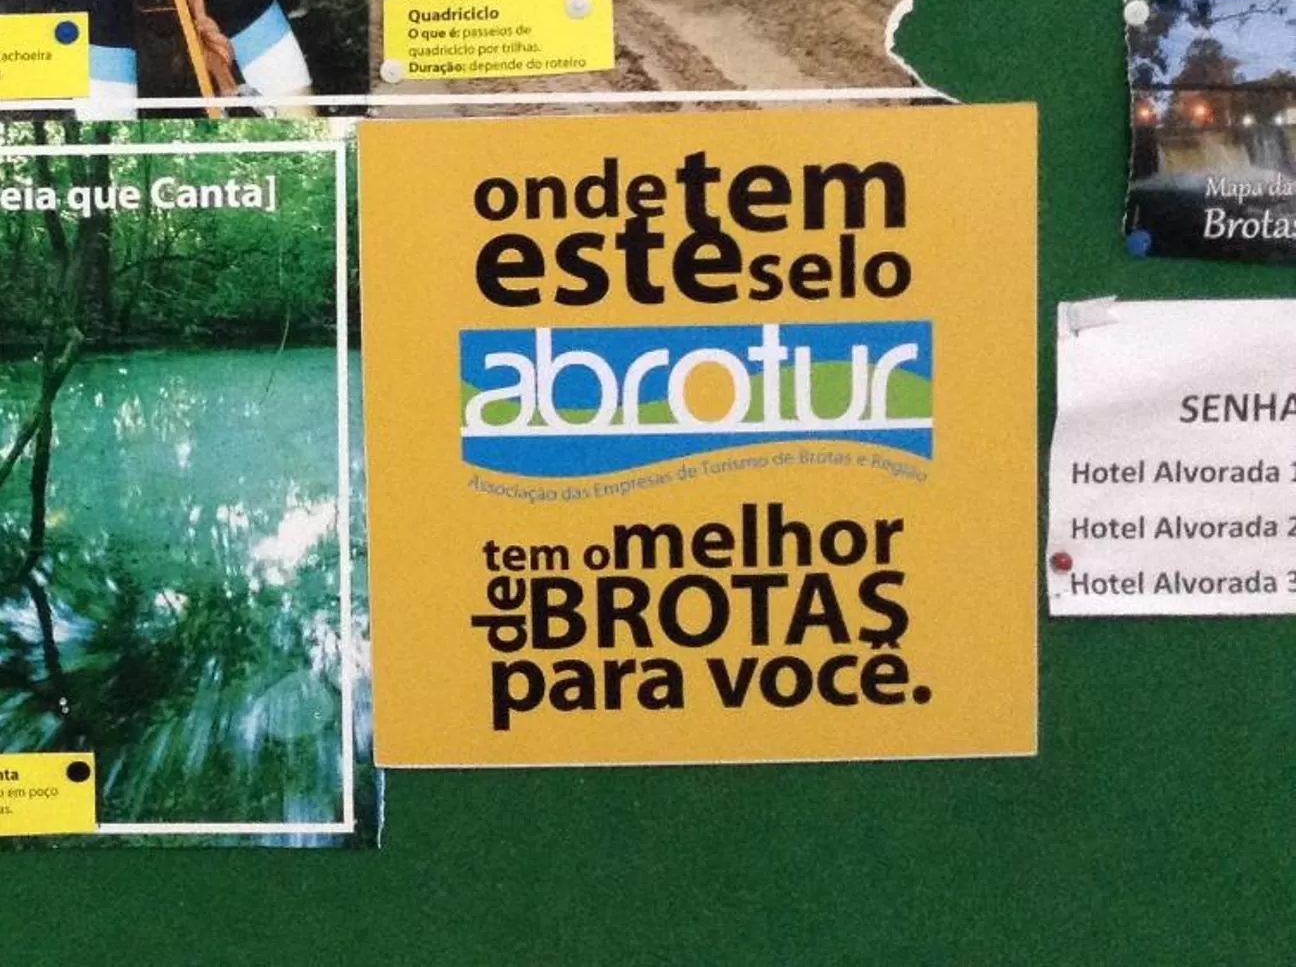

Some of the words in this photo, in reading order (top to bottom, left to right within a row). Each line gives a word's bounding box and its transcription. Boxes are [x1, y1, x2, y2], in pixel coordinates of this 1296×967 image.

[409, 6, 499, 23] Quadriciclo
[408, 28, 418, 39] O
[421, 28, 446, 41] que
[463, 24, 512, 38] passeios
[516, 24, 531, 35] de
[409, 43, 475, 57] quadriciclo
[478, 44, 497, 56] por
[409, 61, 465, 74] Duração:
[469, 59, 523, 72] depende
[526, 57, 542, 70] do
[545, 56, 586, 69] roteiro
[68, 184, 140, 217] que
[152, 175, 276, 212] Canta]
[473, 157, 667, 221] onde
[675, 151, 906, 233] tem
[1206, 177, 1263, 204] Mapa
[1269, 172, 1293, 196] da
[474, 214, 743, 307] este
[748, 234, 912, 301] selo
[464, 323, 919, 428] abrotur
[468, 475, 557, 504] Associação
[561, 486, 589, 500] das
[593, 473, 671, 496] Empresas
[678, 464, 697, 481] de
[703, 455, 768, 475] Turismo
[772, 451, 794, 465] de
[799, 450, 850, 465] Brotas
[857, 456, 865, 466] e
[1072, 460, 1144, 484] Hotel
[1154, 459, 1280, 483] Alvorada
[483, 539, 570, 572] tem
[583, 544, 609, 571] o
[613, 503, 904, 570] melhor
[1071, 516, 1144, 539] Hotel
[1154, 515, 1278, 539] Alvorada
[1070, 572, 1144, 595] Hotel
[1154, 570, 1277, 594] Alvorada
[1287, 571, 1296, 593] 3
[471, 575, 528, 653] de
[531, 570, 909, 649] BROTAS
[491, 654, 684, 731] para
[706, 638, 932, 708] você.
[7, 787, 25, 797] em
[28, 786, 58, 800] poço
